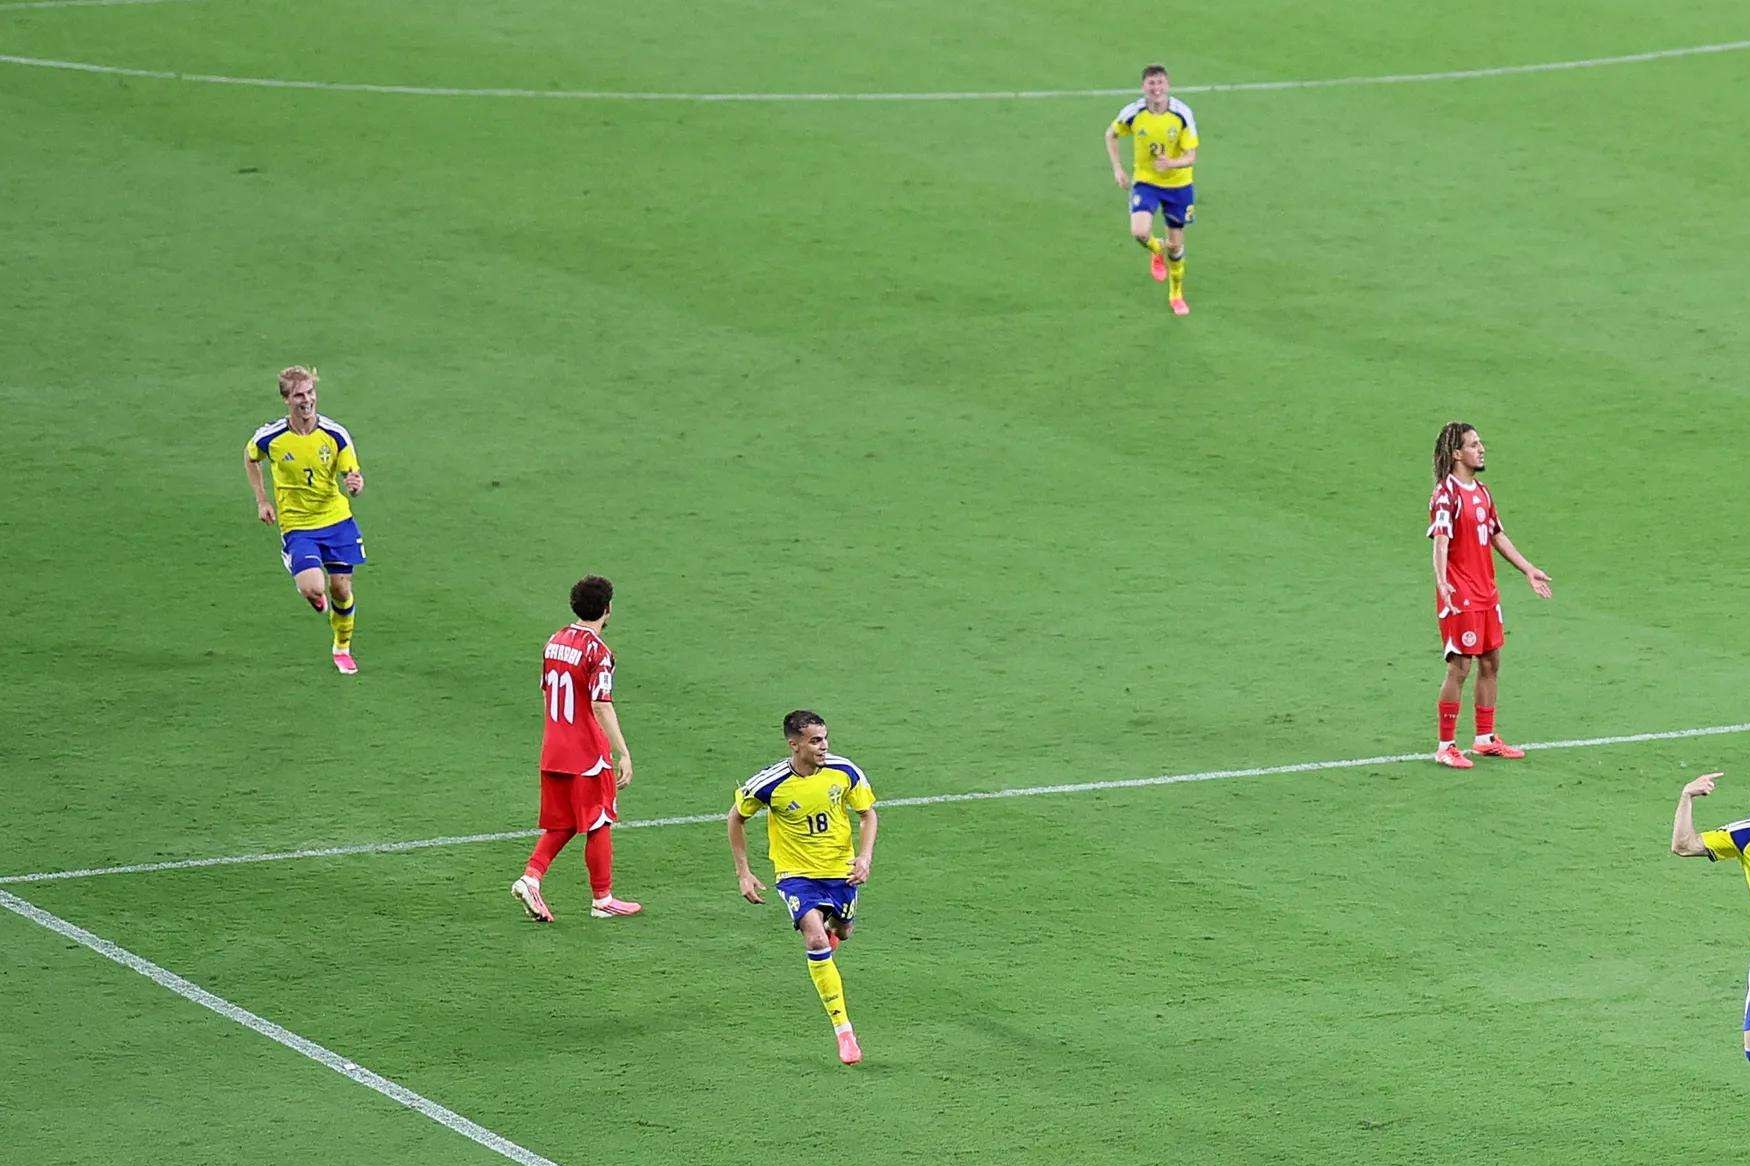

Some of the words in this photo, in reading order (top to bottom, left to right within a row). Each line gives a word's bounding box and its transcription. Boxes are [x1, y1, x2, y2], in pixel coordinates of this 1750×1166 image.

[302, 468, 315, 487] 7
[546, 669, 575, 724] 11
[806, 812, 829, 836] 18
